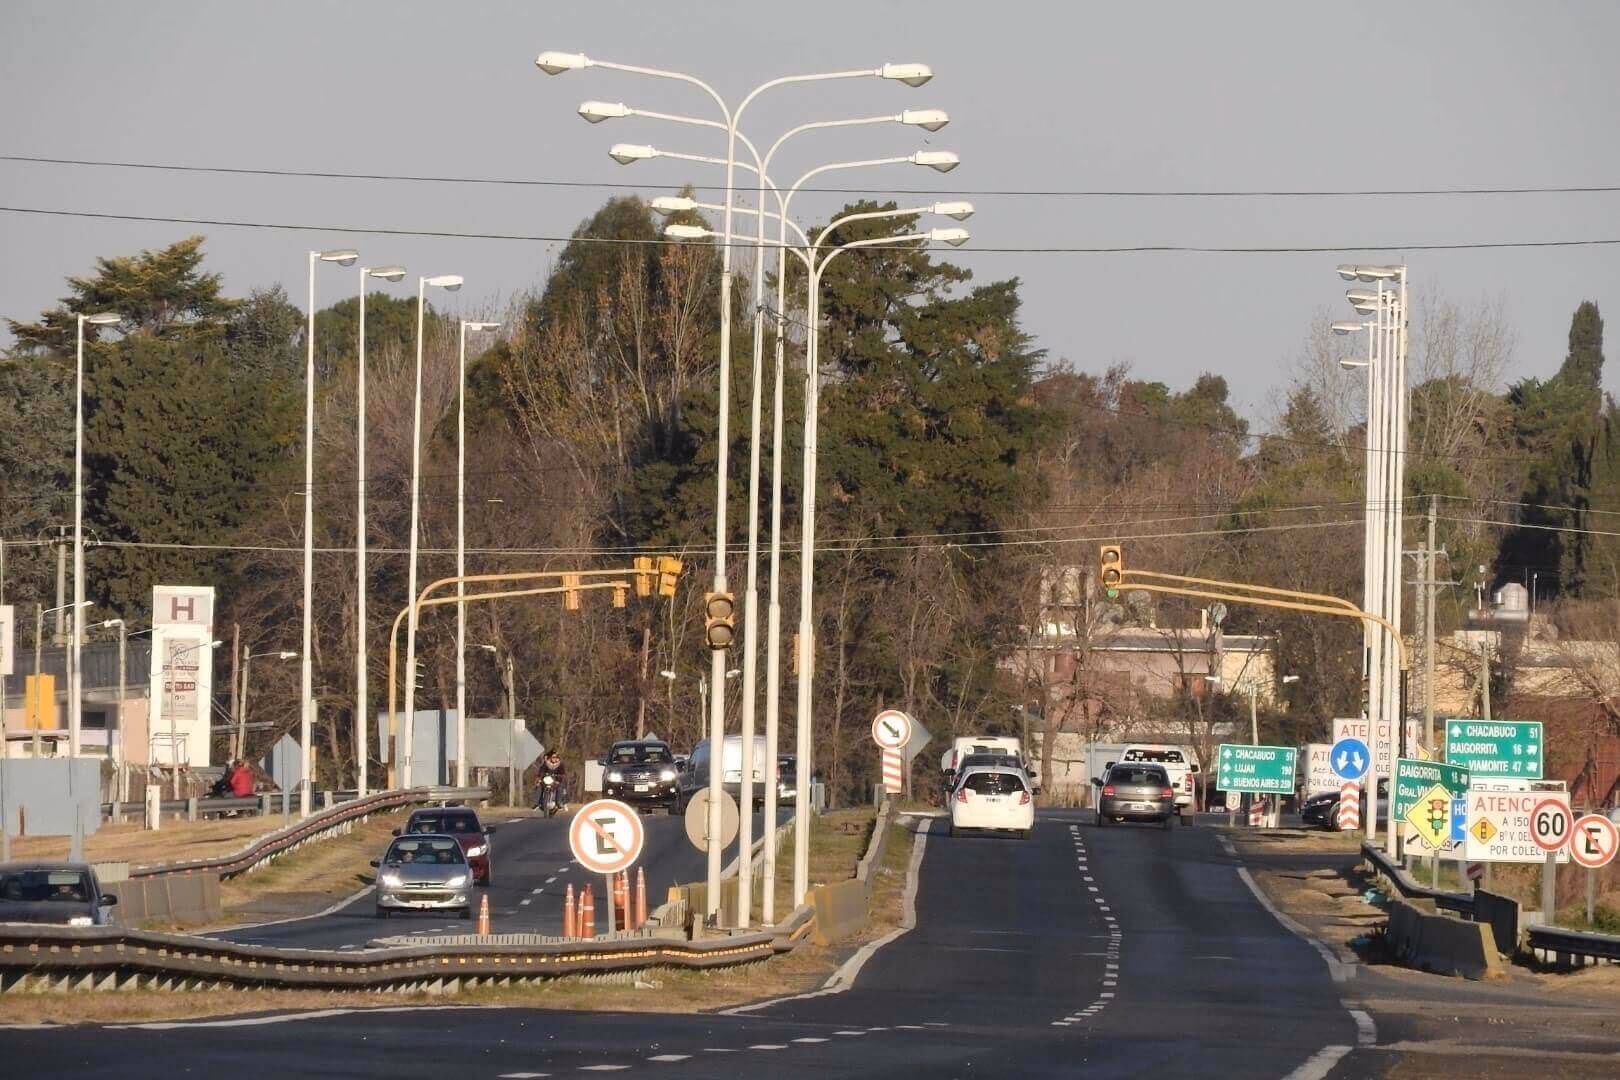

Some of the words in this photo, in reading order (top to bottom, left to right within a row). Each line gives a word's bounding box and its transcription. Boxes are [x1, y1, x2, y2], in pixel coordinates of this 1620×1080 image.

[171, 597, 193, 620] H
[1341, 724, 1411, 738] ATECIN
[1467, 726, 1516, 738] CHACABUCO
[1529, 727, 1538, 739] 51
[1235, 749, 1275, 760] CHACABUCO
[1450, 743, 1498, 754] BAIGORRITA
[1468, 760, 1509, 772] VIAMONTE
[1512, 761, 1522, 772] 47
[1400, 765, 1442, 781] BAIGORRITA
[1233, 777, 1260, 787] BUENOS
[1260, 778, 1279, 788] AIRES
[1537, 812, 1564, 836] 60
[594, 817, 617, 854] E
[1585, 828, 1601, 854] E
[1490, 846, 1508, 856] POR
